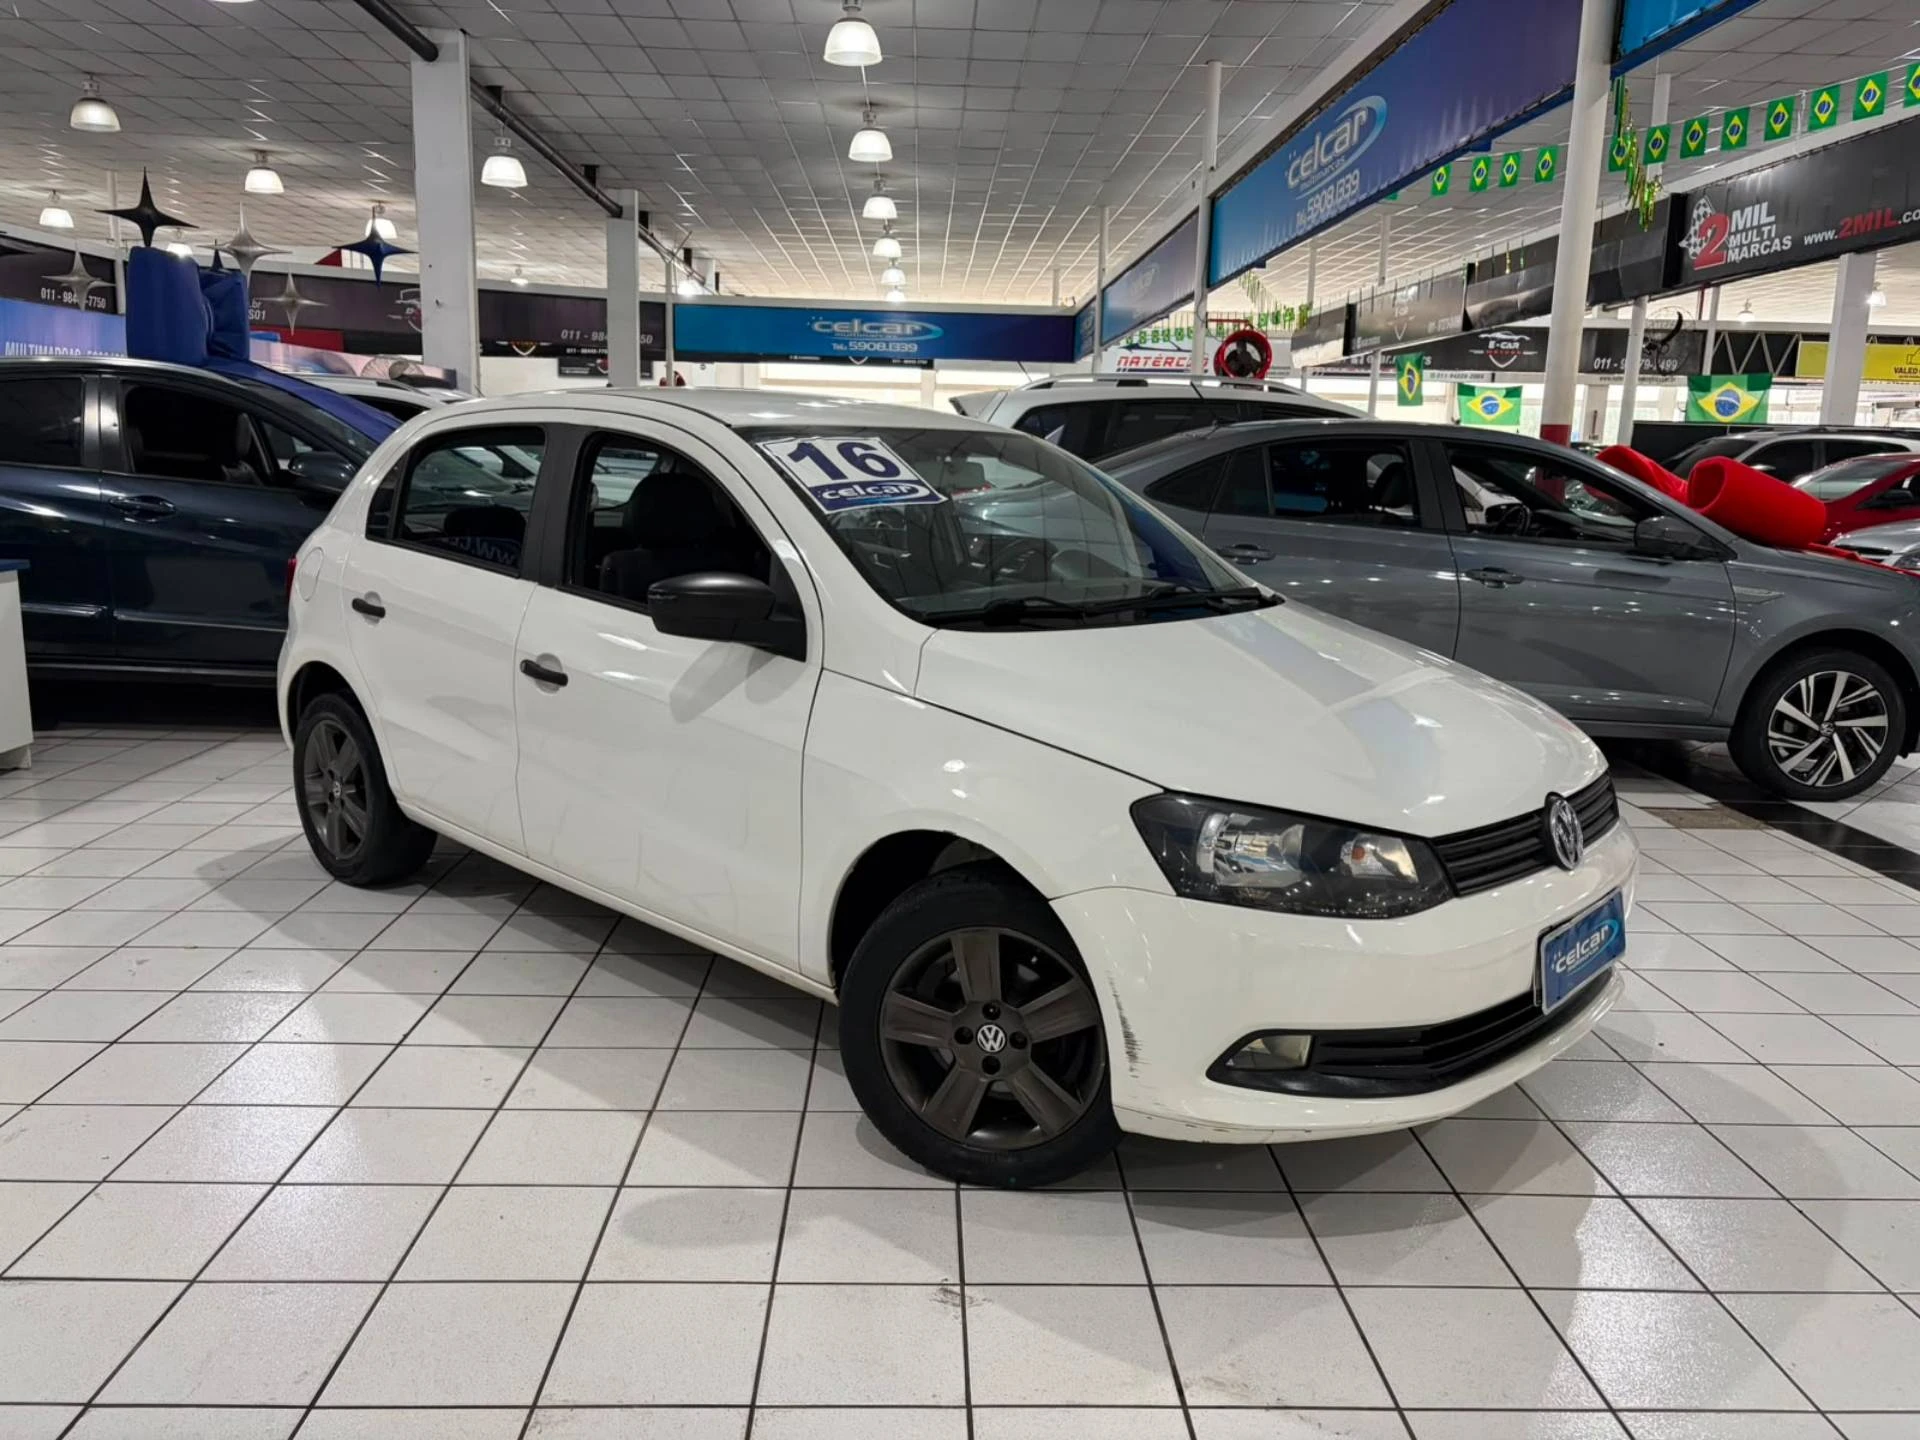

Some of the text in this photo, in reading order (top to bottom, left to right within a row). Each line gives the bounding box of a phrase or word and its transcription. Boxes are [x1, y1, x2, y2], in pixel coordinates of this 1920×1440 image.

[1287, 107, 1369, 188] celcar
[1730, 201, 1776, 232] MIL
[1693, 212, 1729, 270] 2
[1728, 223, 1777, 247] MULTI
[1727, 235, 1792, 263] MARCAS
[41, 287, 55, 301] 011
[812, 318, 922, 335] celcar
[848, 340, 918, 352] 5908.1339
[1593, 357, 1611, 370] 011
[787, 441, 901, 481] 16
[822, 482, 914, 500] celcar
[1555, 925, 1609, 974] celcar
